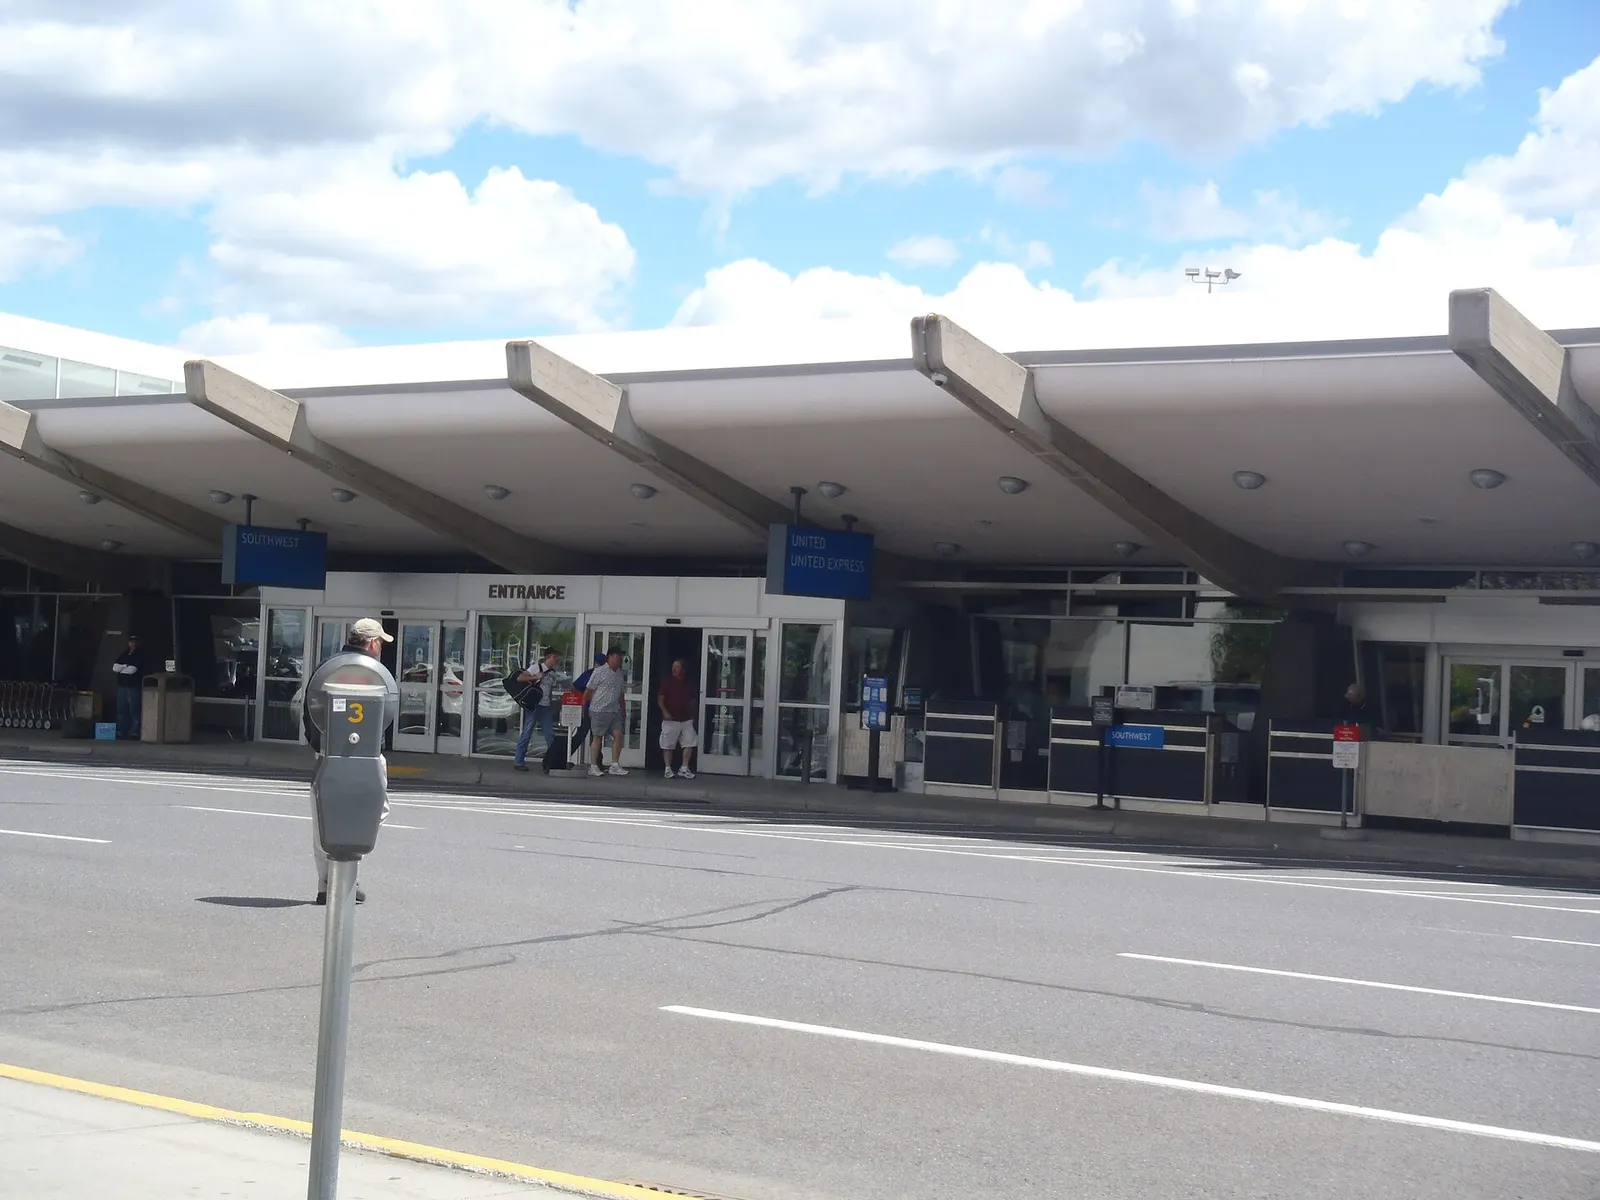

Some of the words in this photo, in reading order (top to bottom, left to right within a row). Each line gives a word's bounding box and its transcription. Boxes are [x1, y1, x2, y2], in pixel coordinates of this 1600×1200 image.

[241, 532, 300, 548] SOUTHWEST
[791, 533, 826, 550] UNITED
[790, 553, 825, 569] UNITED
[827, 557, 865, 573] EXPRESS
[488, 584, 566, 600] ENTRANCE
[348, 702, 364, 723] 3
[1111, 731, 1152, 741] SOUTHWEST
